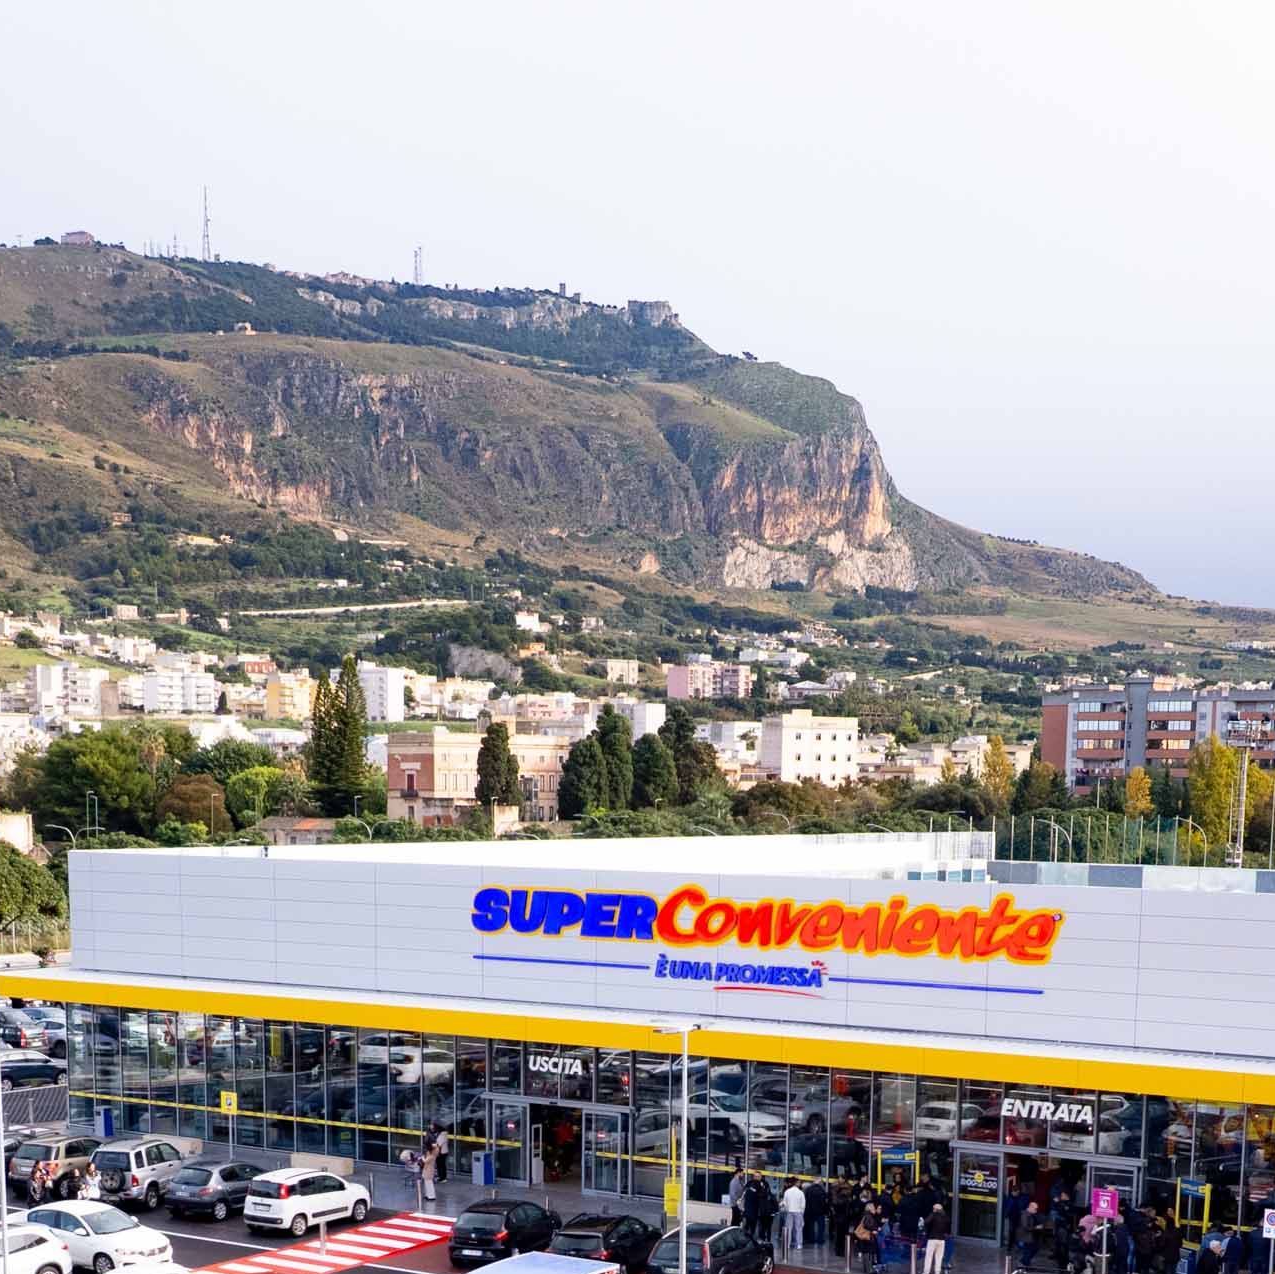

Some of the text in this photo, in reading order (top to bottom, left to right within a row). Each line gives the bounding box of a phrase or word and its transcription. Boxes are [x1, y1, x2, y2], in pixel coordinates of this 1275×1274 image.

[655, 953, 822, 987] È UNA PROMESSA
[529, 1055, 583, 1075] USCITA
[1001, 1098, 1093, 1124] ENTRATA
